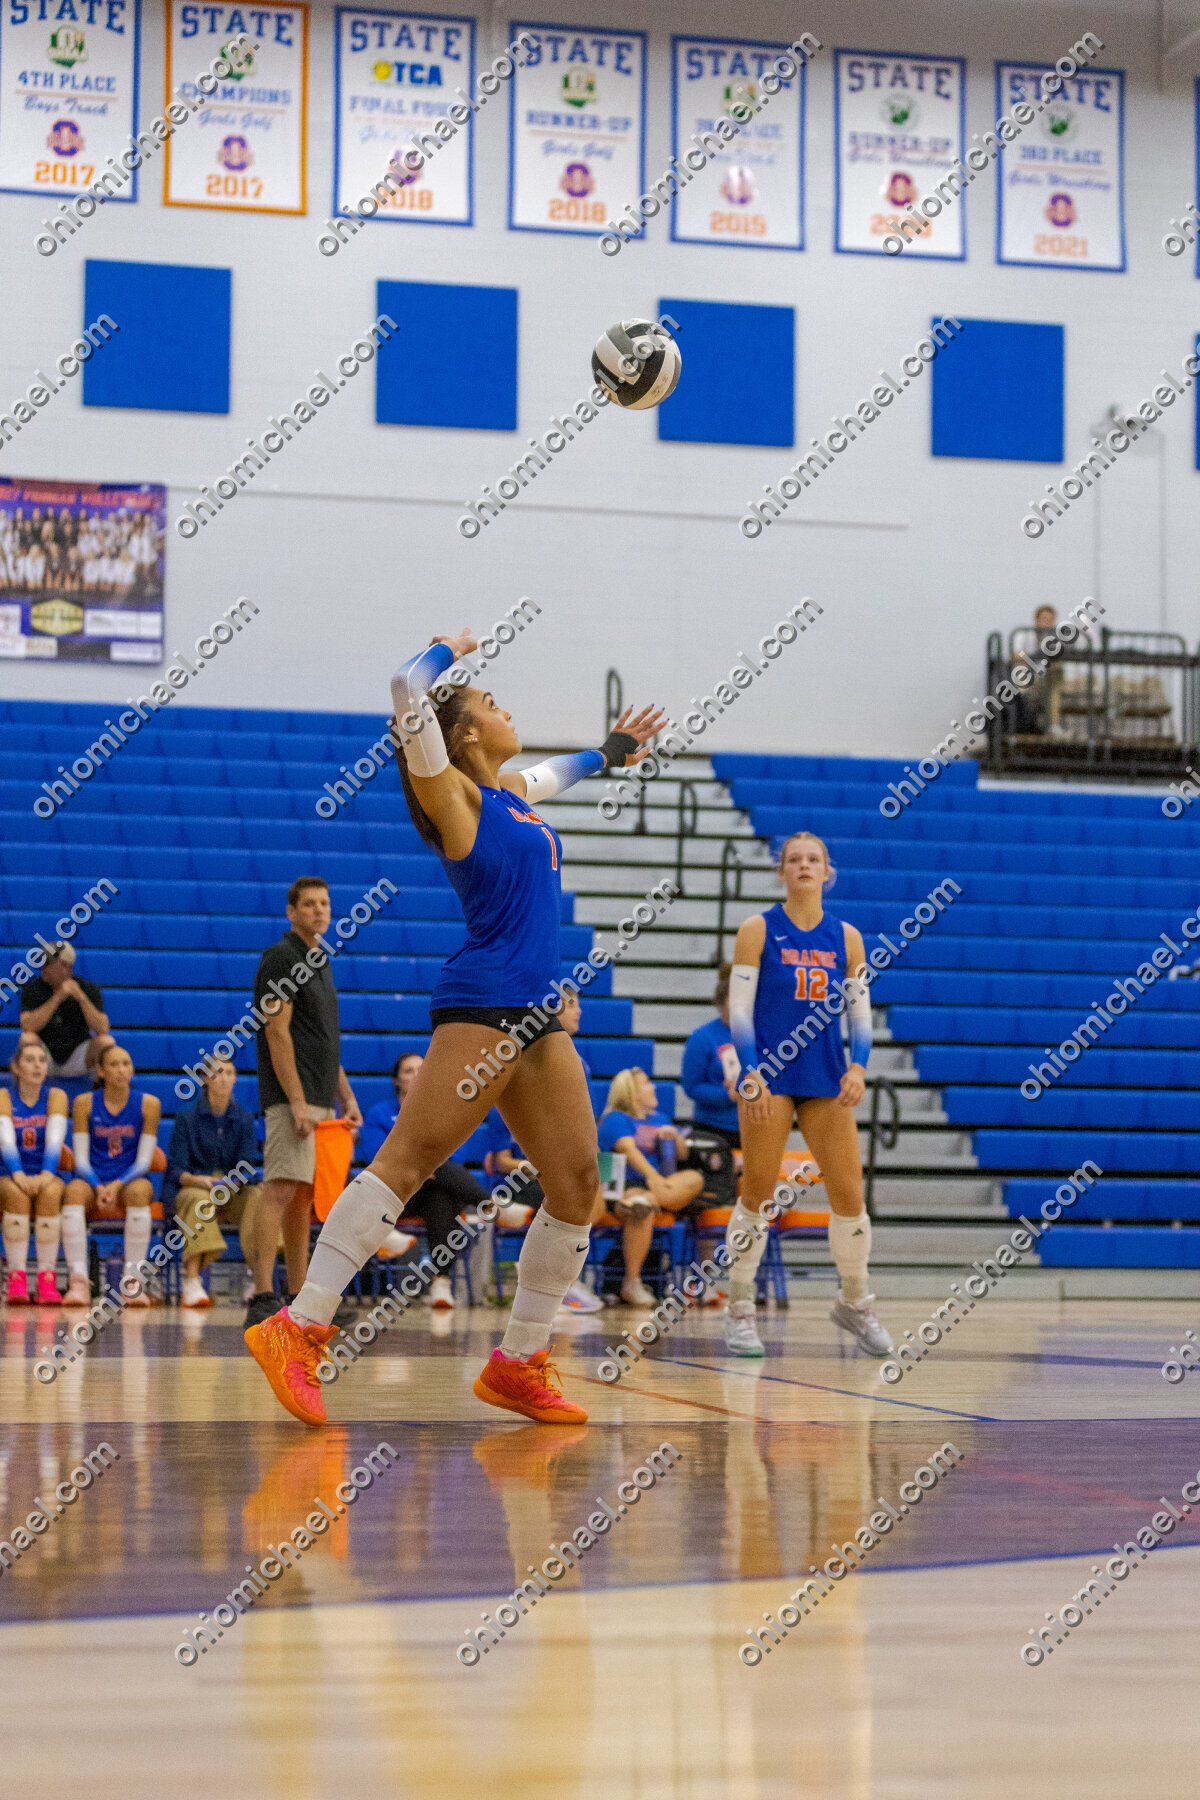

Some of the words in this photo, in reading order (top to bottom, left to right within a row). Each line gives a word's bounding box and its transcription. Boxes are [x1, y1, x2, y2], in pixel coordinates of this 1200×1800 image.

[10, 0, 126, 35] STATE
[181, 5, 294, 47] STATE
[350, 19, 463, 61] STATE
[521, 34, 633, 76] STATE
[18, 69, 55, 88] 4TH
[59, 72, 117, 94] PLACE
[686, 47, 792, 89] STAT
[847, 60, 952, 100] STATE
[34, 160, 96, 187] 2017
[205, 173, 265, 199] 2017
[548, 197, 607, 223] 2018
[793, 966, 830, 1002] 12
